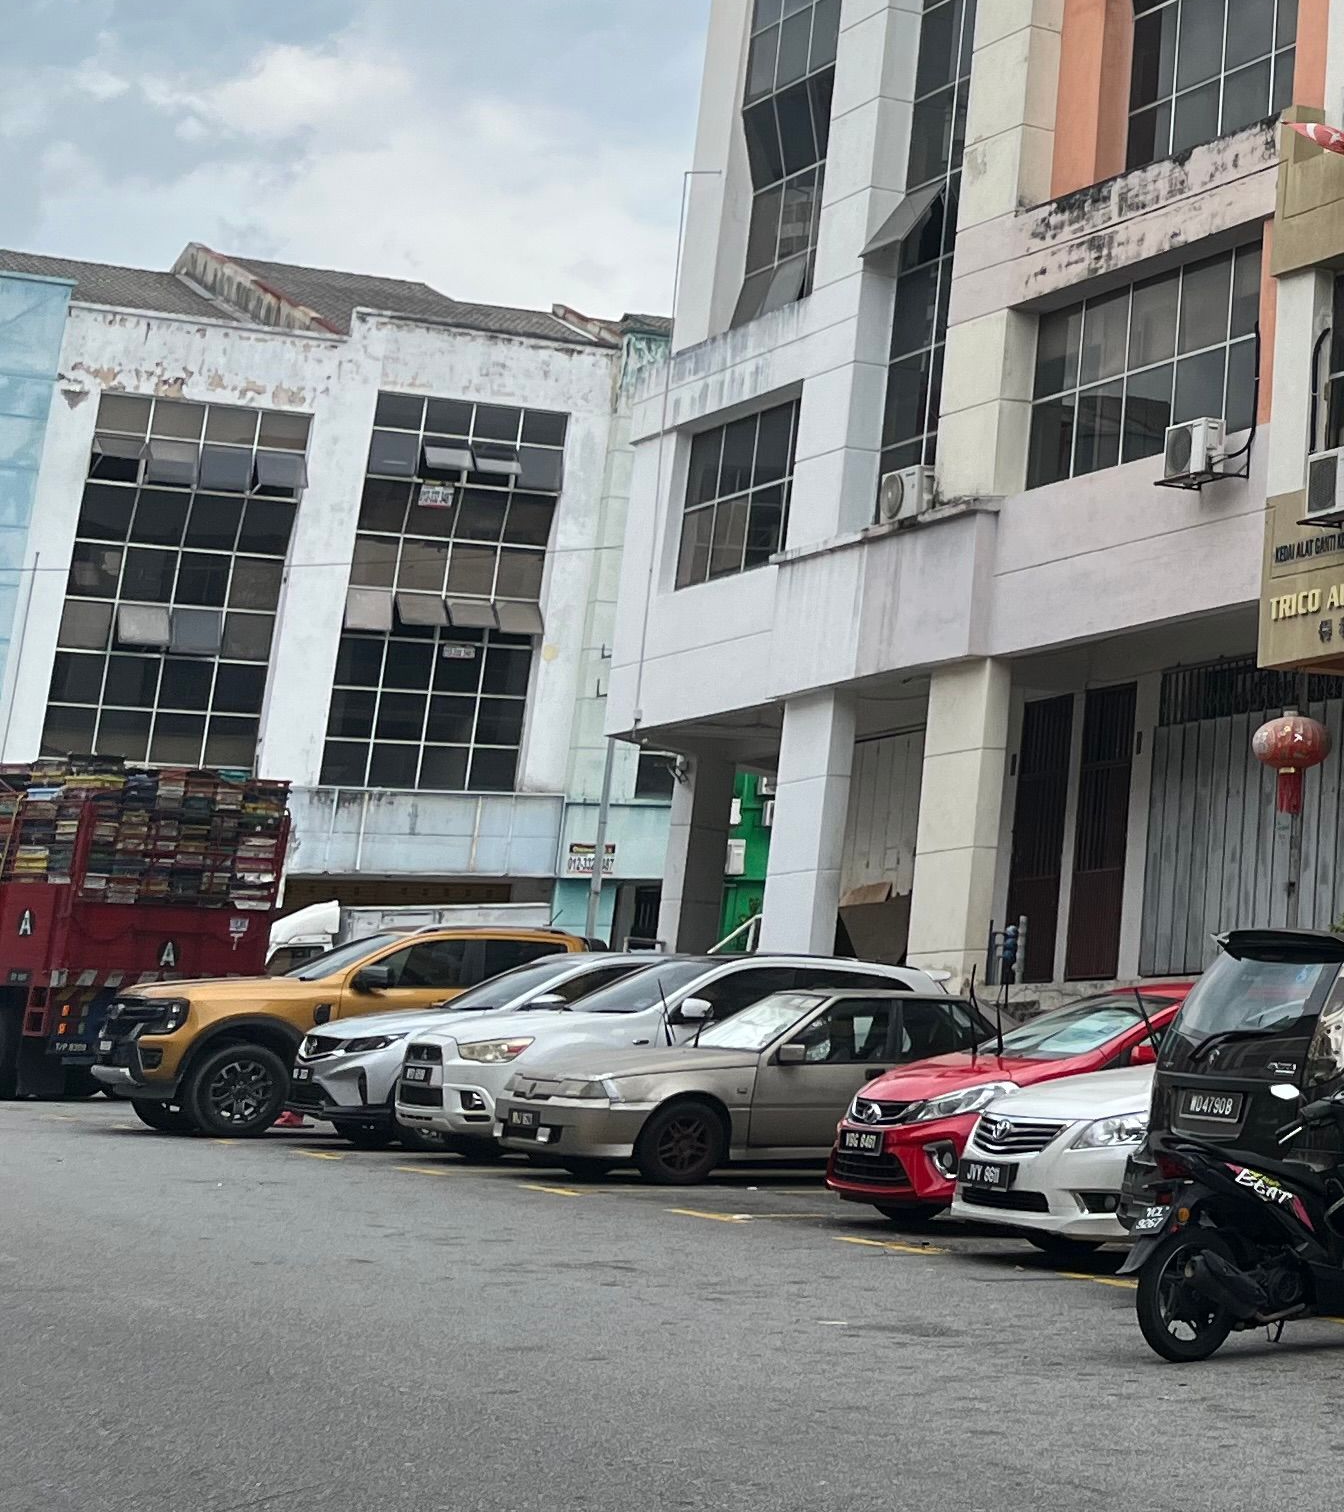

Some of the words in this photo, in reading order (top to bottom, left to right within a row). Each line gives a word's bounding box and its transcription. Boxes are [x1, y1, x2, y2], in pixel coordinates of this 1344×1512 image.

[1296, 539, 1314, 558] ALAT
[1270, 588, 1321, 620] TRICO
[18, 909, 32, 935] A
[160, 942, 175, 967] A
